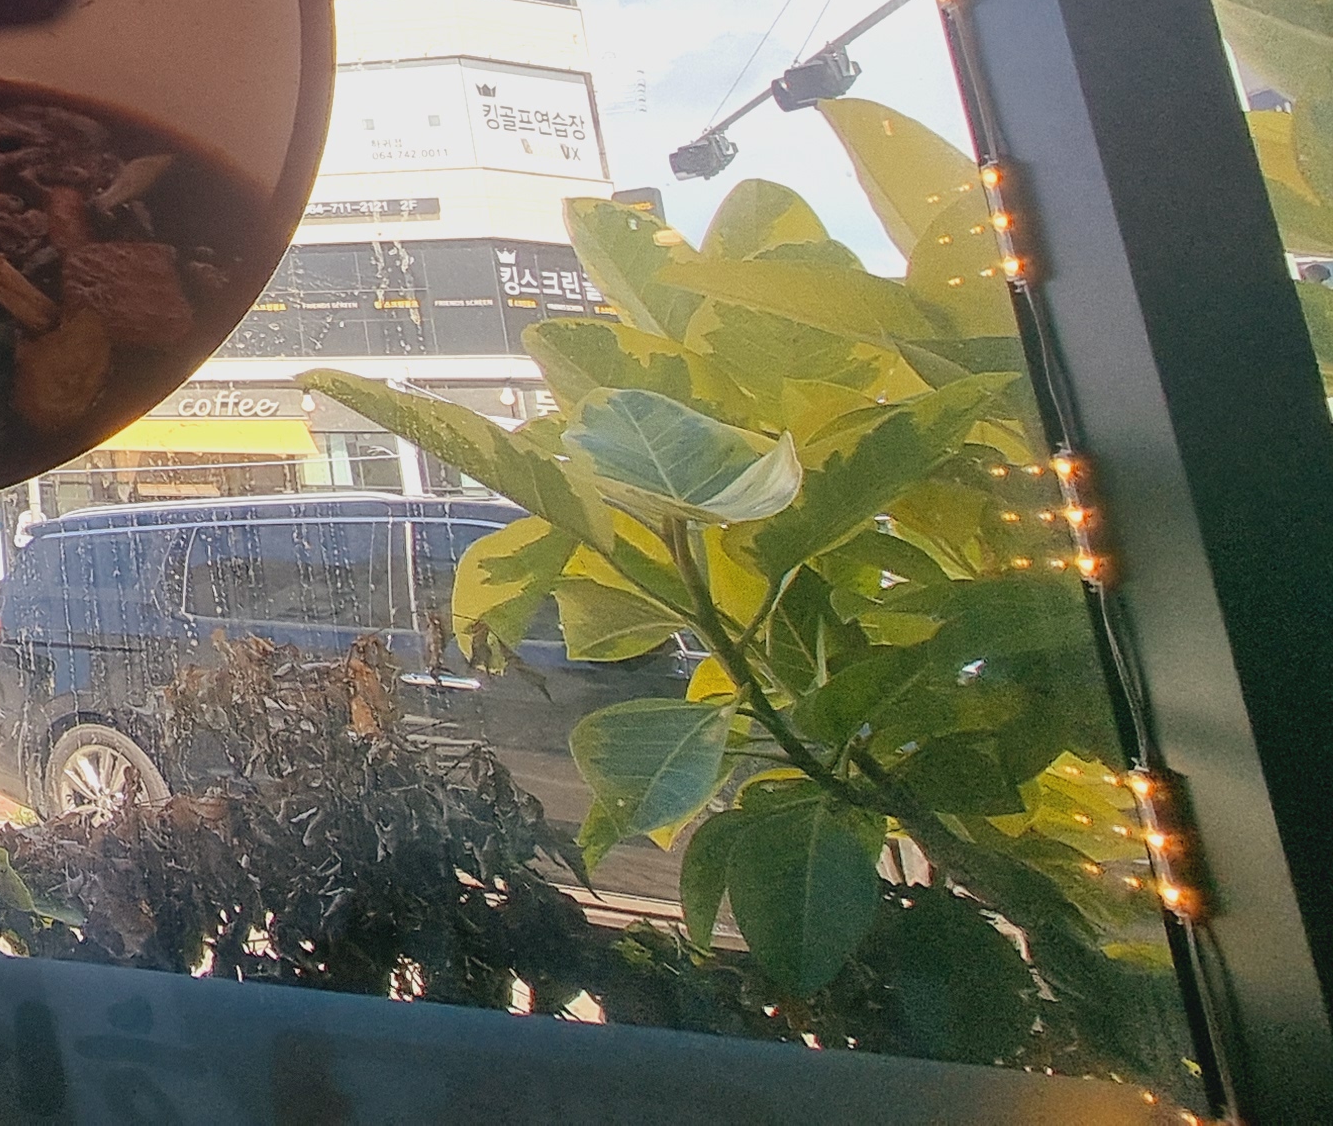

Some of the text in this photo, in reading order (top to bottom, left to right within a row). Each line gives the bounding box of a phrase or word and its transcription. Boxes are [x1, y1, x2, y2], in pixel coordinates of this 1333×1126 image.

[482, 104, 586, 141] 킹골프연습장
[399, 199, 418, 212] 2F
[178, 390, 280, 417] coffee
